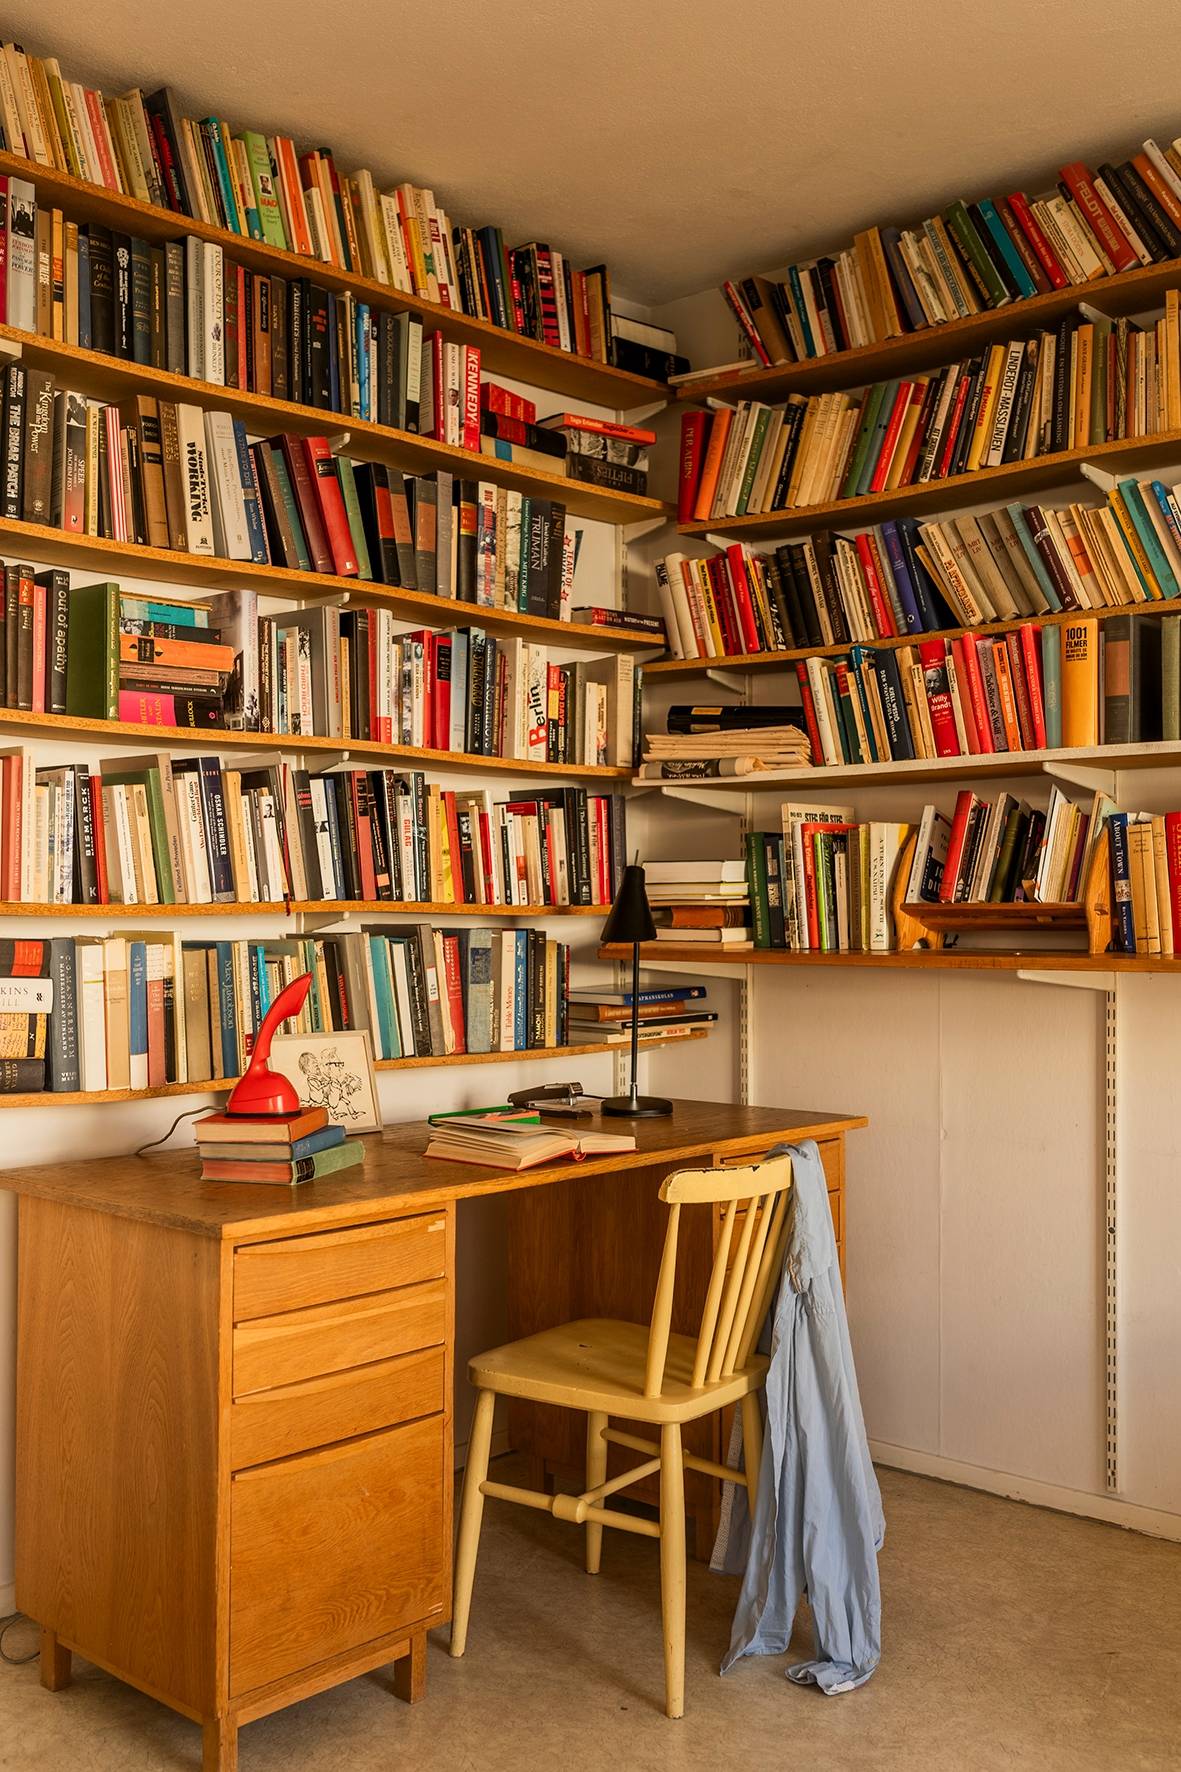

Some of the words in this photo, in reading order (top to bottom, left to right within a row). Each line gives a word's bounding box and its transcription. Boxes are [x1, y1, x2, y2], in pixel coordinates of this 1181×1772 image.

[1075, 180, 1103, 219] FELDT
[38, 251, 48, 263] GAY
[39, 263, 49, 285] TALESE
[215, 277, 221, 291] OF
[1059, 357, 1064, 368] EN
[467, 352, 476, 422] KENNEDY
[9, 404, 20, 426] THE
[40, 390, 51, 433] Kingdom
[1057, 400, 1062, 413] OM
[29, 422, 41, 453] Power
[685, 425, 694, 449] PER
[931, 427, 940, 437] ATT
[7, 427, 19, 462] BRIAR
[926, 436, 937, 455] SKRIVA
[77, 459, 85, 484] SPEER
[241, 458, 247, 470] TO
[682, 449, 692, 481] ALBIN
[6, 462, 18, 498] PATCH
[186, 441, 201, 522] WORKING
[242, 471, 250, 486] DIE
[199, 479, 208, 515] Terkel
[484, 489, 492, 501] BIG
[529, 515, 541, 570] TRUMAN
[656, 563, 669, 587] PALME
[943, 559, 955, 571] PÅ
[565, 577, 572, 589] OF
[947, 569, 977, 619] AFTONBLADET
[57, 590, 66, 614] out
[57, 615, 66, 627] of
[1064, 627, 1087, 639] 1001
[54, 629, 67, 674] apathy
[1065, 640, 1087, 648] FILMER
[471, 654, 483, 707] STALINGRAD
[879, 669, 887, 682] DEN
[882, 682, 893, 720] SVAVELGULA
[888, 686, 896, 702] KJELL
[930, 695, 948, 704] Willy
[985, 673, 997, 708] Tadellöser
[991, 716, 1001, 735] Wolff
[484, 683, 495, 749] Romanovs
[528, 686, 546, 747] Berlin
[890, 702, 900, 722] WESTÖ
[929, 702, 951, 711] Brandt
[889, 720, 897, 742] HIMLEN
[214, 794, 222, 815] OSKAR
[81, 786, 91, 856] BISMARCK
[403, 818, 411, 846] GULAG
[217, 818, 226, 855] SCHINDLER
[1112, 819, 1122, 848] ABOUT
[1115, 849, 1124, 874] TOWN
[224, 960, 232, 981] Max
[61, 1010, 65, 1018] AV
[66, 975, 74, 1058] MANNERHEIM
[222, 982, 234, 1029] Jakobson
[504, 1010, 512, 1028] Table
